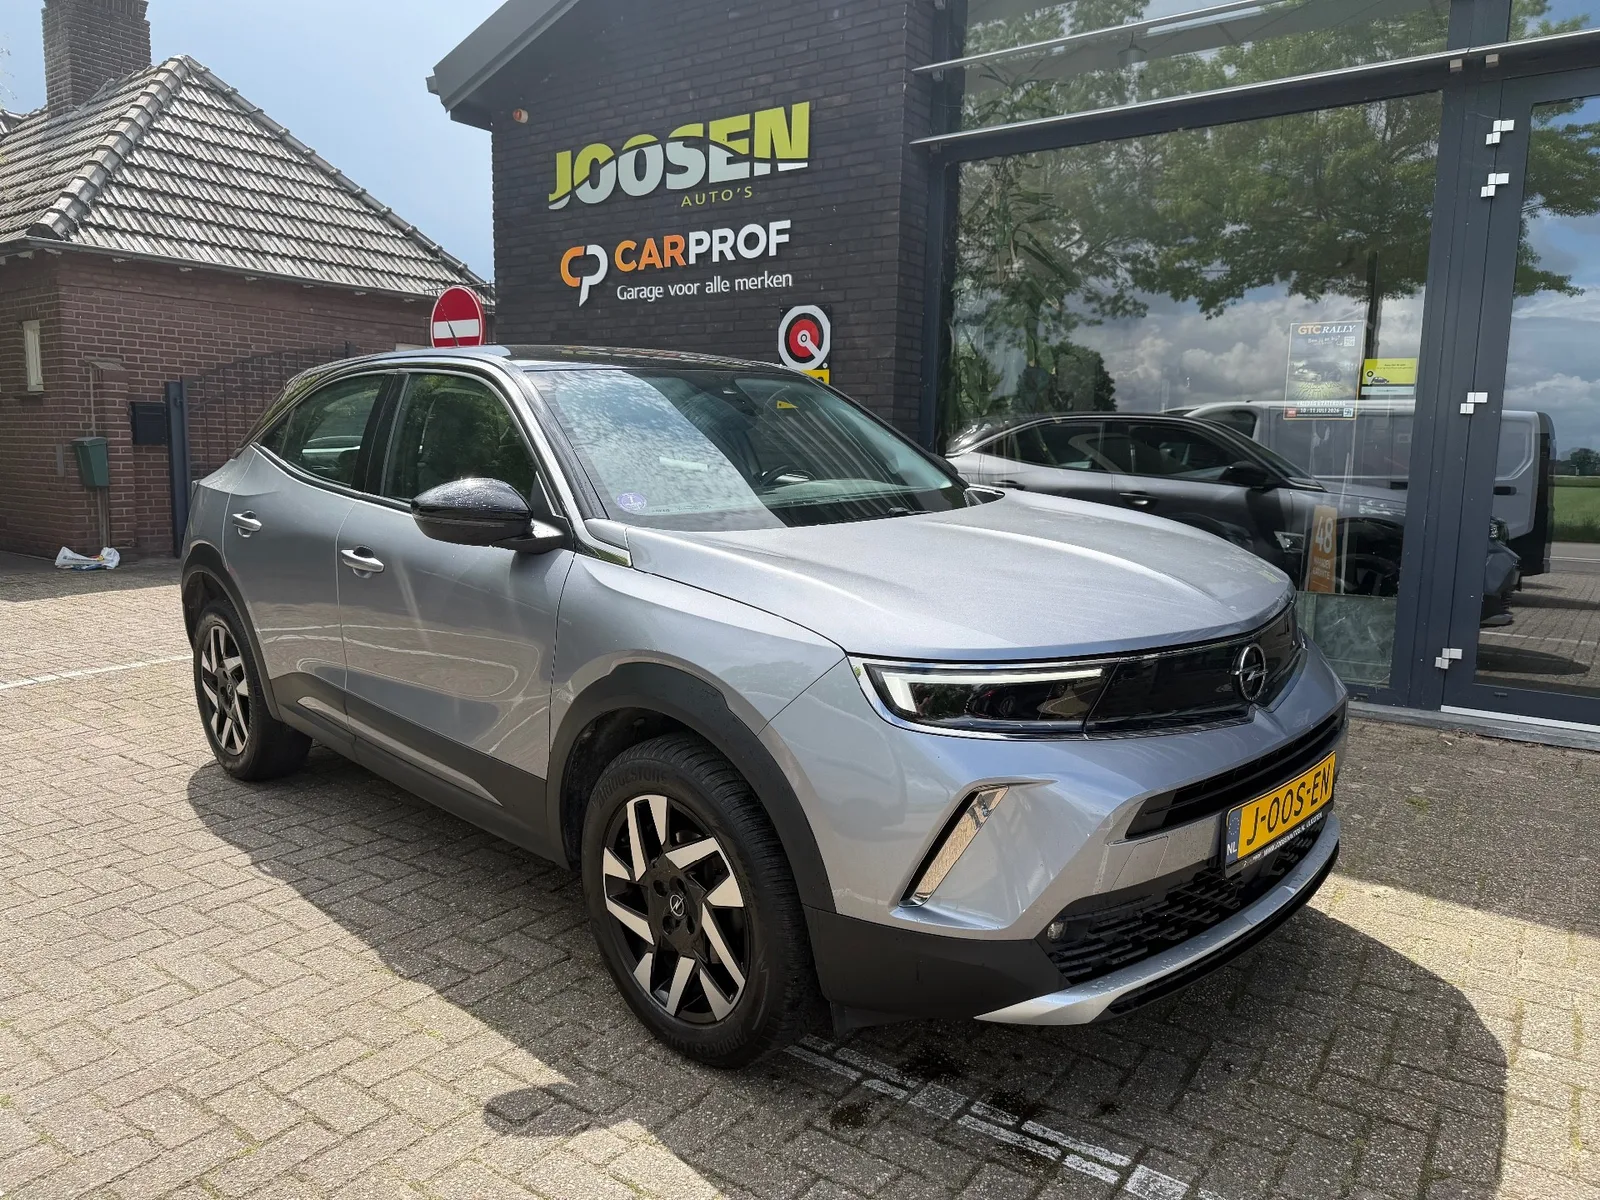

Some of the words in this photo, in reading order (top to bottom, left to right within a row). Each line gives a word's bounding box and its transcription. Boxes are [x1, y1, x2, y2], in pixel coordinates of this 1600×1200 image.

[548, 101, 810, 210] JOOSEN
[680, 186, 753, 208] AUTO'S
[614, 219, 792, 272] CARPROF
[616, 284, 664, 302] Garage
[668, 283, 700, 297] voor
[705, 276, 730, 293] alle
[735, 271, 793, 291] merken
[1298, 325, 1321, 335] GTC
[1322, 325, 1356, 334] RALLY
[1315, 515, 1334, 554] 48
[1226, 841, 1238, 856] NL
